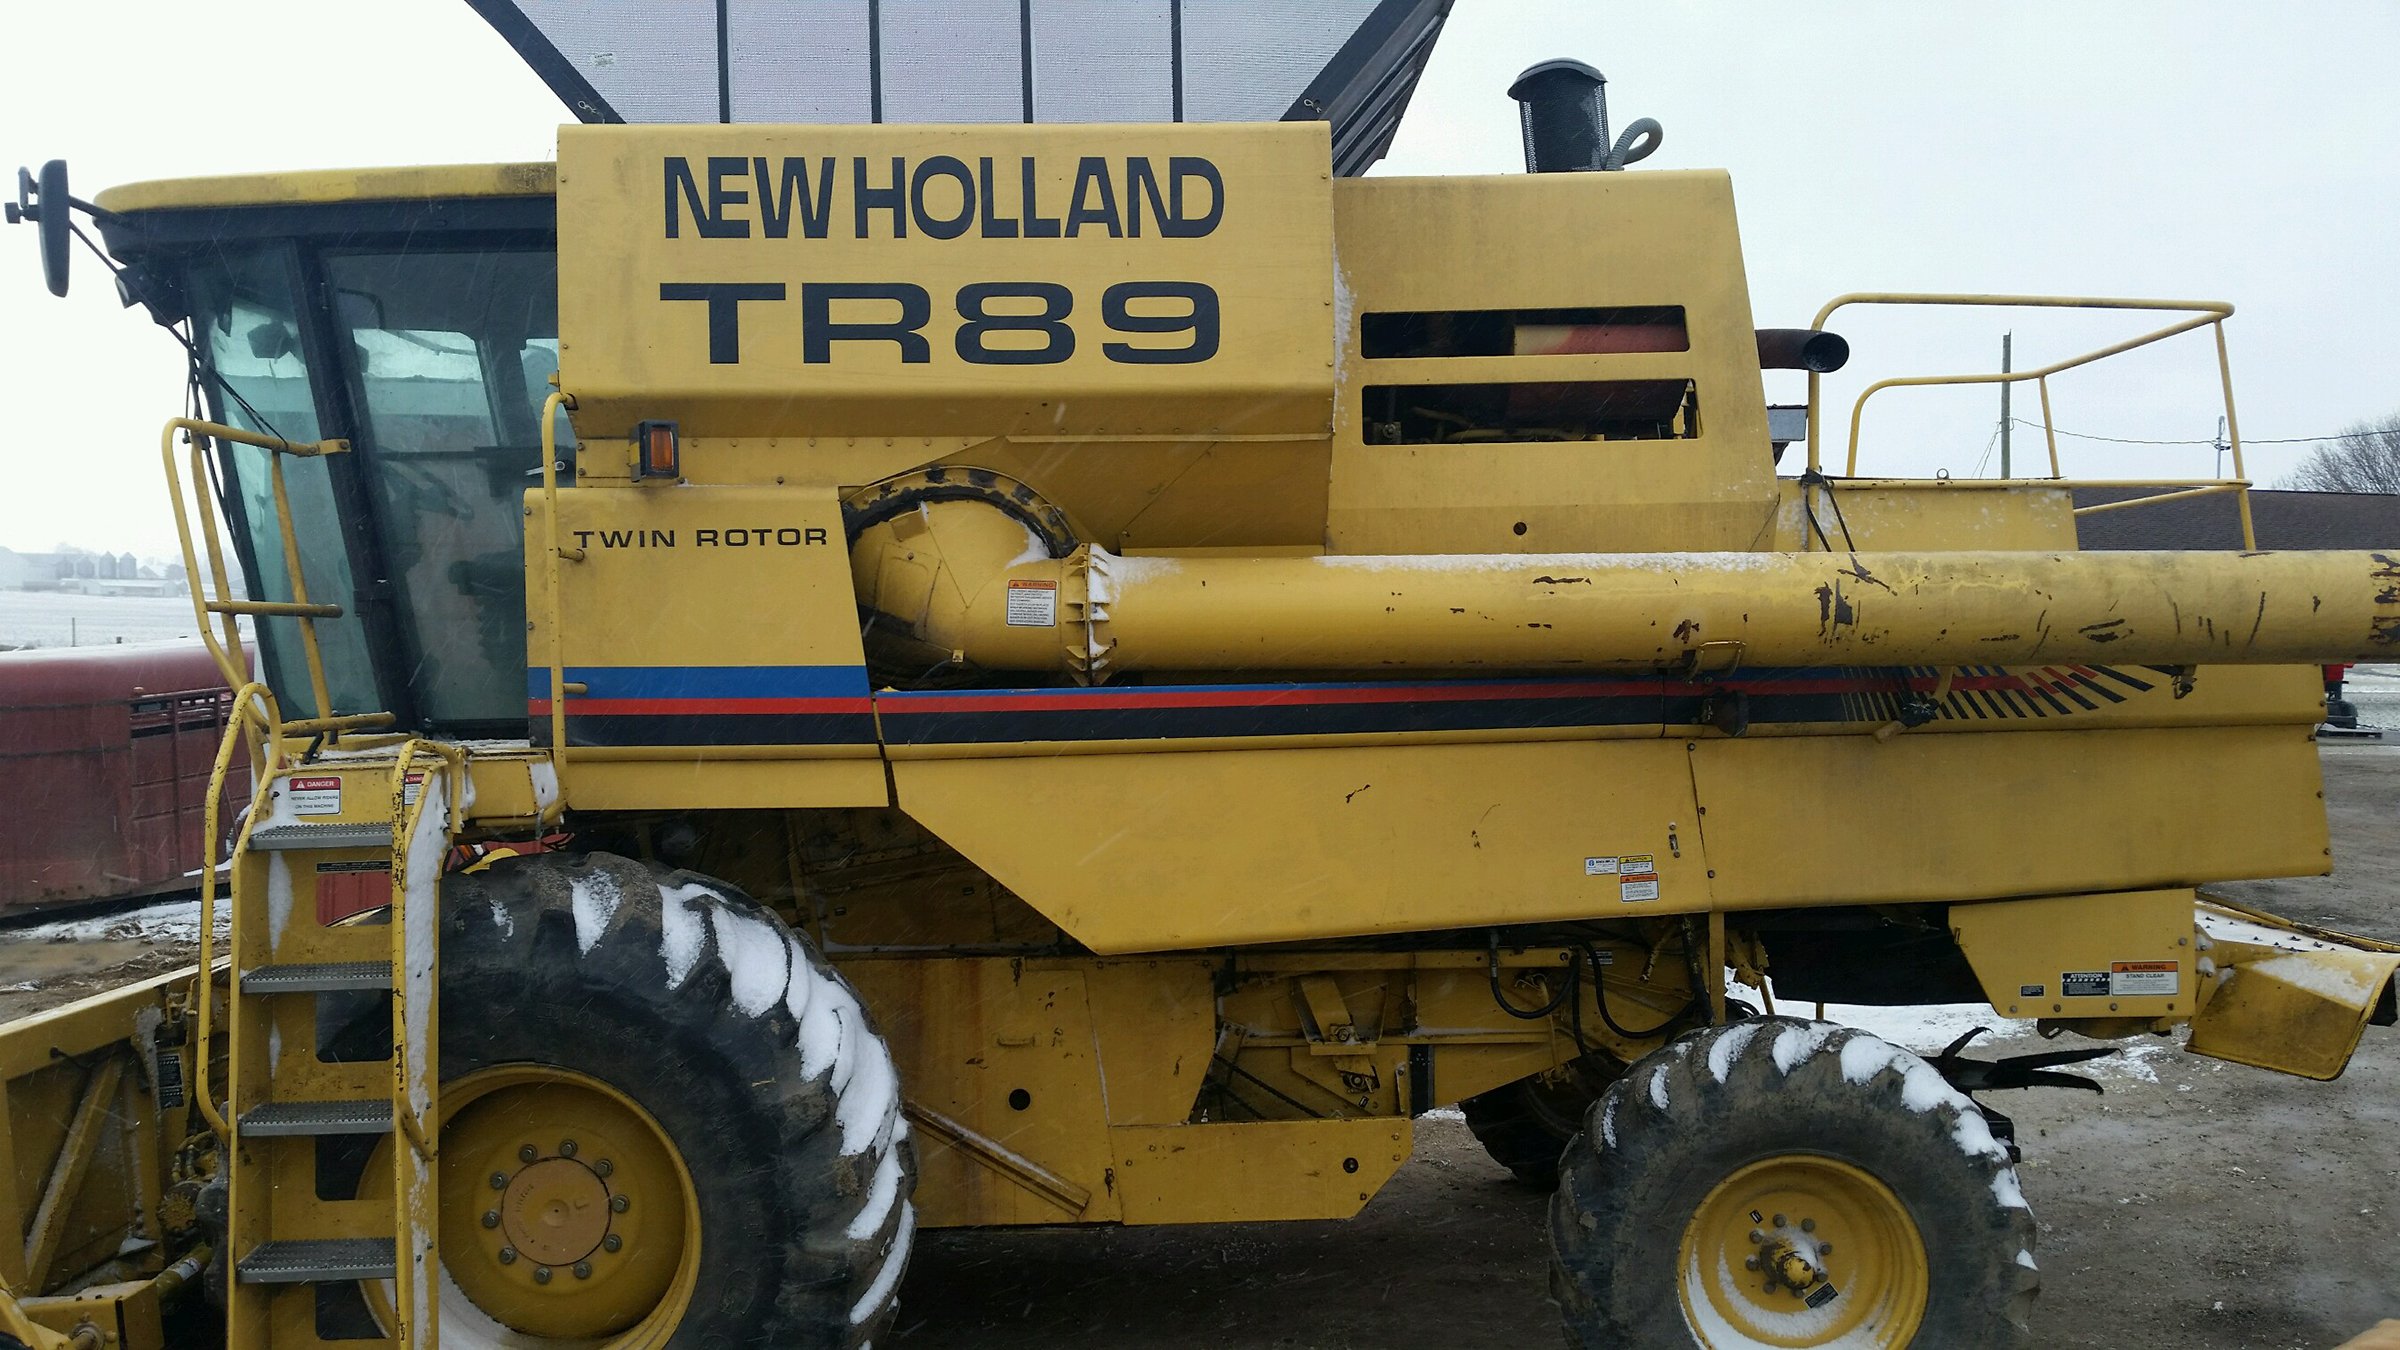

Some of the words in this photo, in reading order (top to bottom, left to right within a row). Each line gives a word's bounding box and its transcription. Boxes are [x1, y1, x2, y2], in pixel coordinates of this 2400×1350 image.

[664, 156, 836, 239] NEW
[853, 155, 1225, 240] HOLLAND
[660, 281, 1221, 366] TR89
[573, 529, 675, 548] TWIN
[696, 528, 827, 546] ROTOR
[306, 780, 335, 788] DANGER
